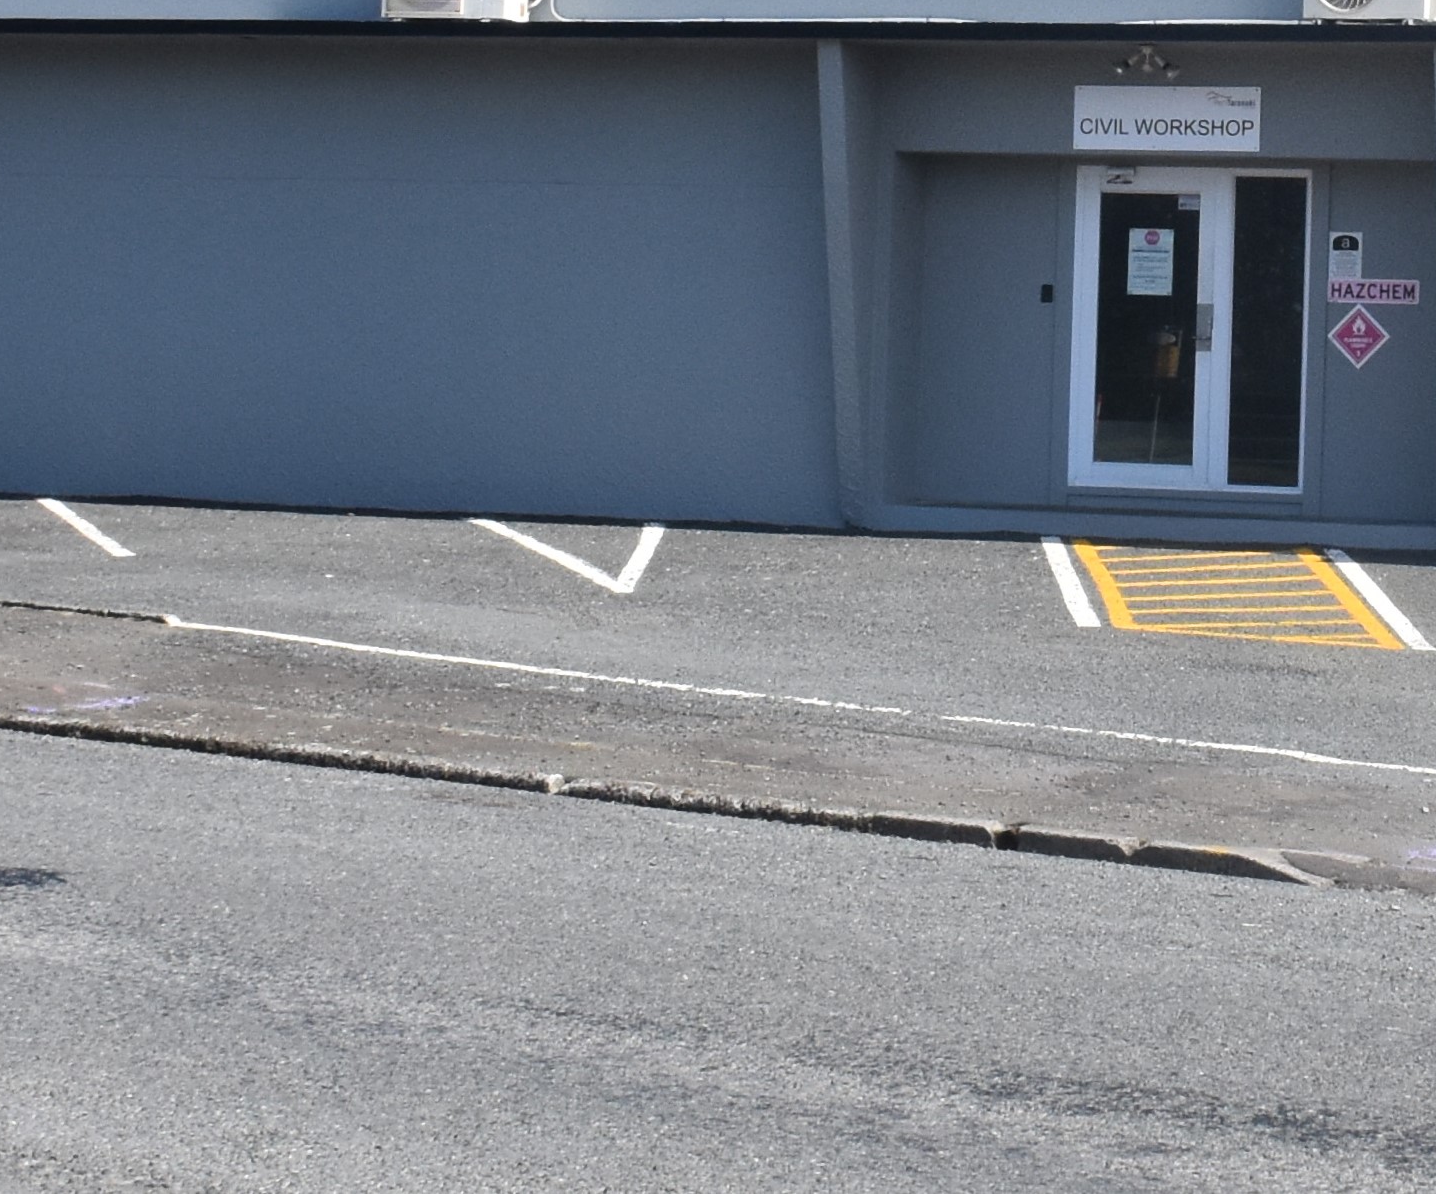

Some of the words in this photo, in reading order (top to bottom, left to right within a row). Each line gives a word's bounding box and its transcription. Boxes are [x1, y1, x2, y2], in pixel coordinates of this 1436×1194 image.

[1080, 118, 1128, 135] CIVIL
[1135, 119, 1254, 136] WORKSHOP
[1331, 283, 1415, 300] HAZCHEM
